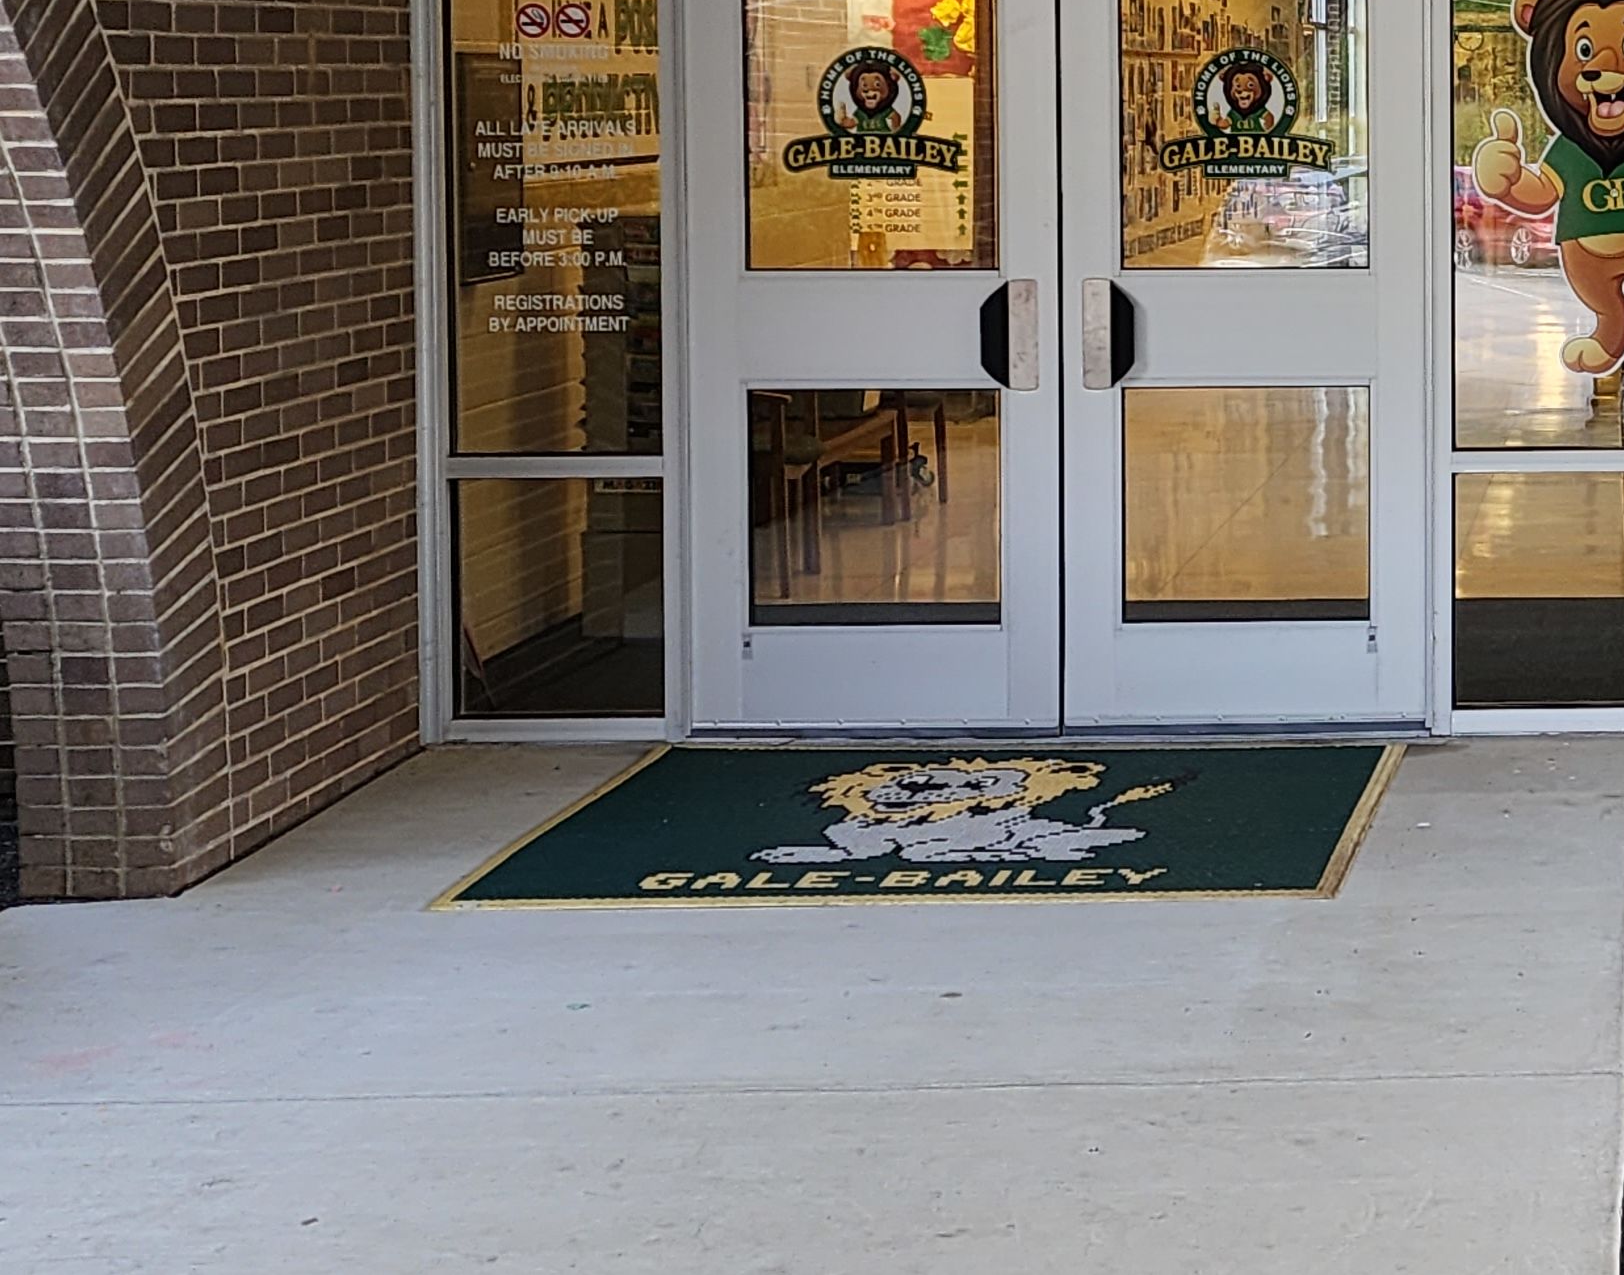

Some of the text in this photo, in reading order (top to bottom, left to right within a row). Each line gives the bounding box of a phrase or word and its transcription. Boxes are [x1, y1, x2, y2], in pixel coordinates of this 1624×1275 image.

[500, 43, 522, 59] NO
[821, 49, 924, 99] HOME OF THE LIONS
[1195, 49, 1297, 101] HOME OF THE LIONS
[475, 121, 638, 136] ALL LATE ARRIVALS
[478, 142, 523, 158] MUST
[556, 143, 614, 157] SIGNED
[788, 135, 957, 168] GALE-BAILEY
[1163, 136, 1330, 169] GALE-BAILEY
[494, 165, 545, 180] AFTER
[832, 164, 912, 175] ELEMENTARY
[1206, 165, 1285, 174] ELEMENTARY
[885, 194, 922, 202] GRADE
[496, 208, 619, 223] EARLY PICK-UP
[885, 209, 921, 217] GRADE
[885, 224, 921, 232] GRADE
[523, 230, 593, 244] MUST BE
[489, 252, 555, 266] BEFORE
[595, 252, 627, 266] P.M.
[494, 295, 624, 310] REGISTRATIONS
[489, 317, 629, 331] BY APPOINTMENT
[638, 866, 1170, 891] GALE-BAILEY
